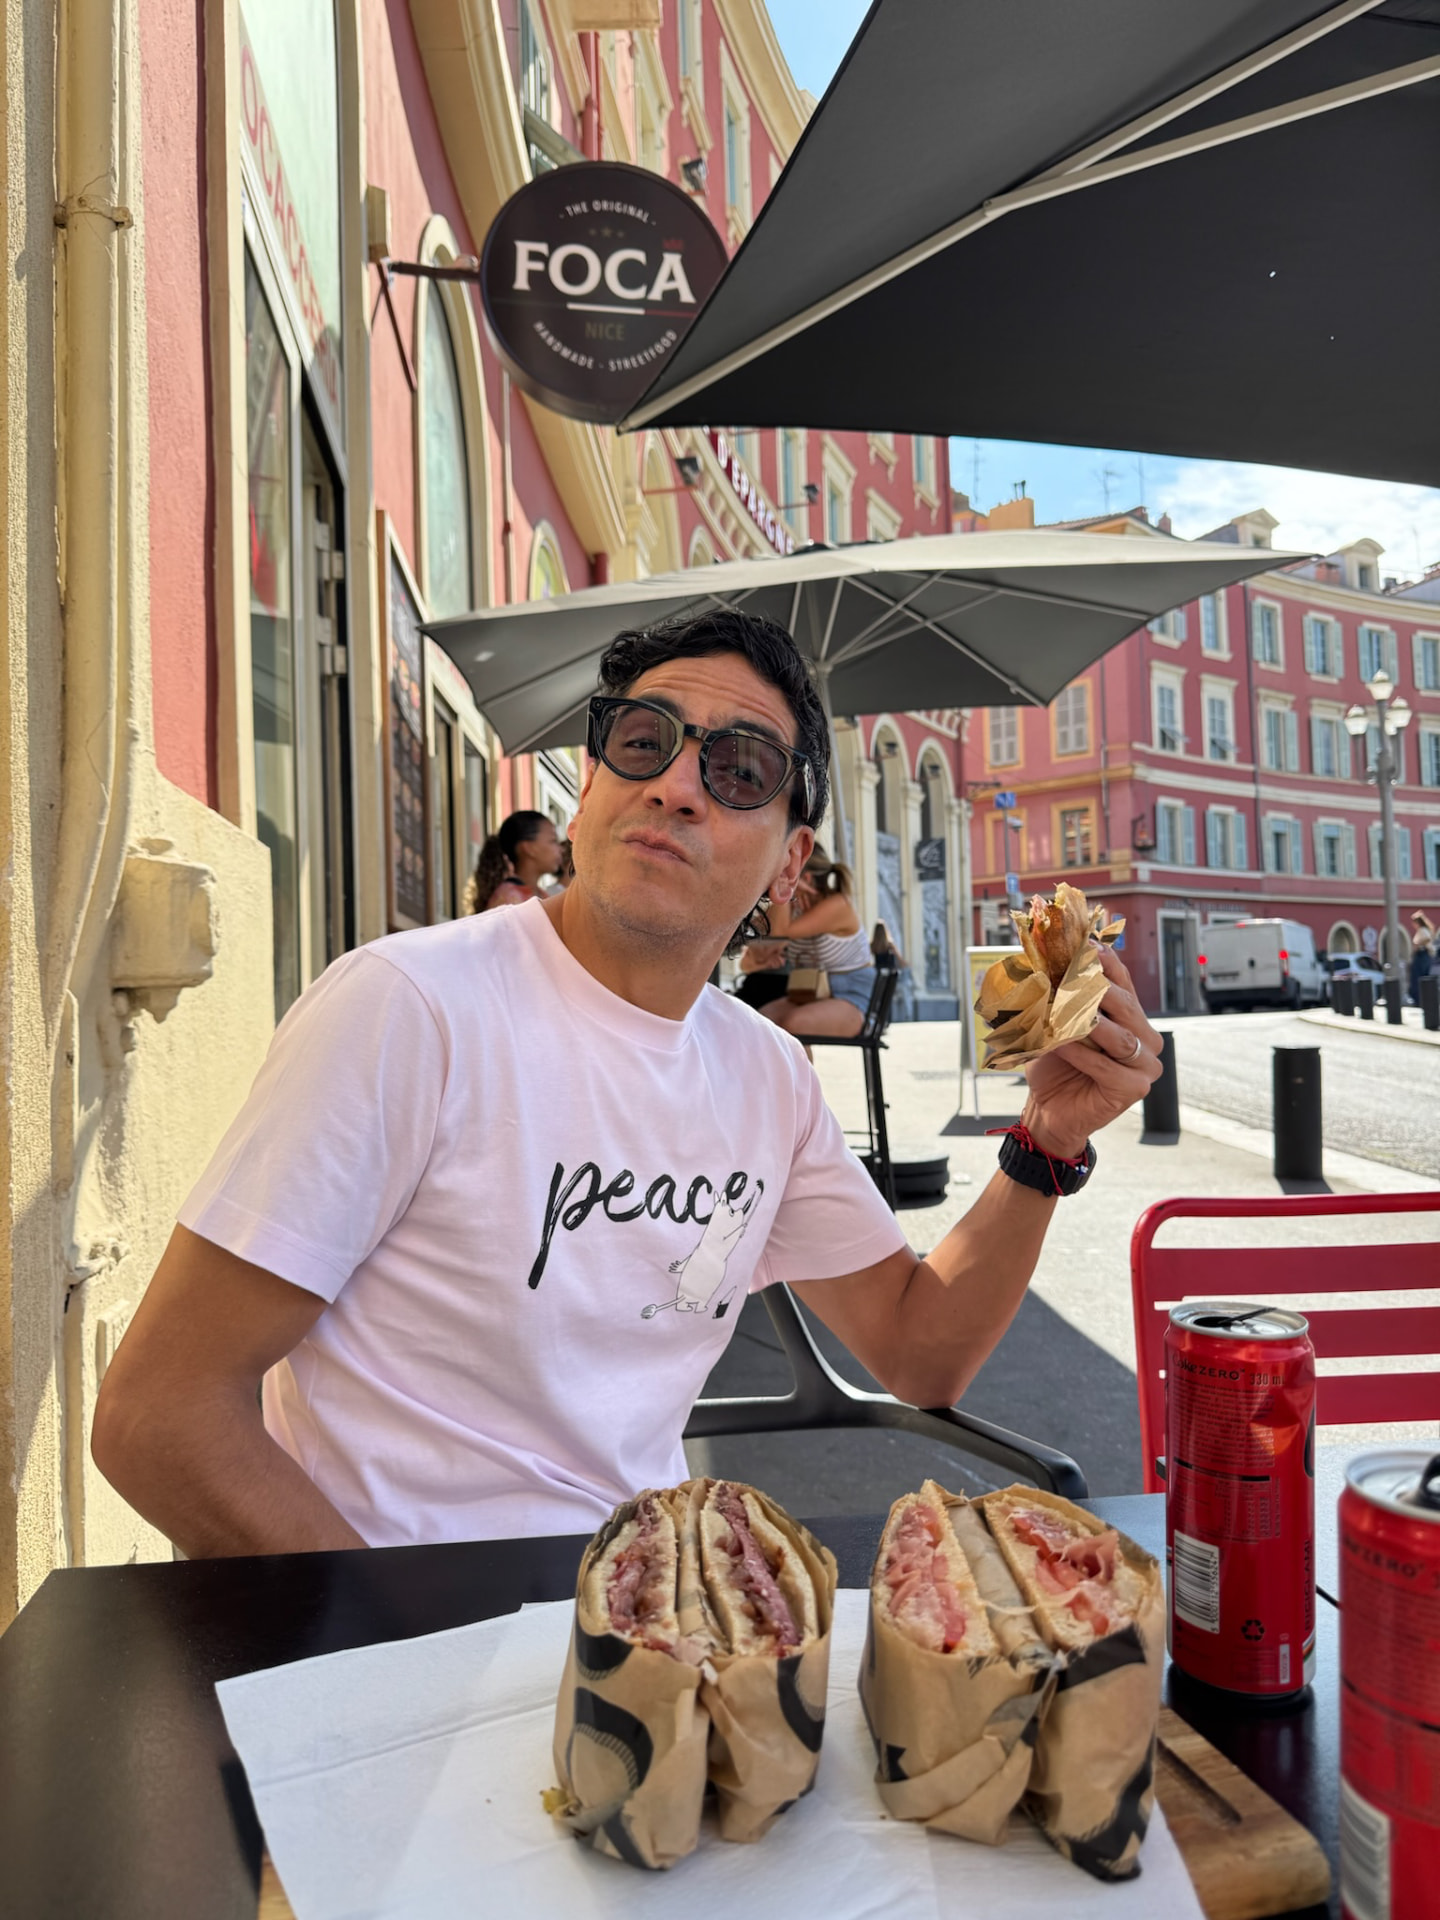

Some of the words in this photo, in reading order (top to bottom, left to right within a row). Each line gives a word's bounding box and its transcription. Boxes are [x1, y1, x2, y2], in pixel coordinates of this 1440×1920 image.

[565, 201, 589, 218] THE
[592, 200, 650, 224] ORIGINAL
[512, 240, 697, 304] FOCA
[533, 321, 594, 370] HANDMADE
[608, 329, 678, 372] STREETFOOD
[585, 321, 625, 341] NICE
[528, 1161, 753, 1290] peace
[1249, 1373, 1269, 1386] 330
